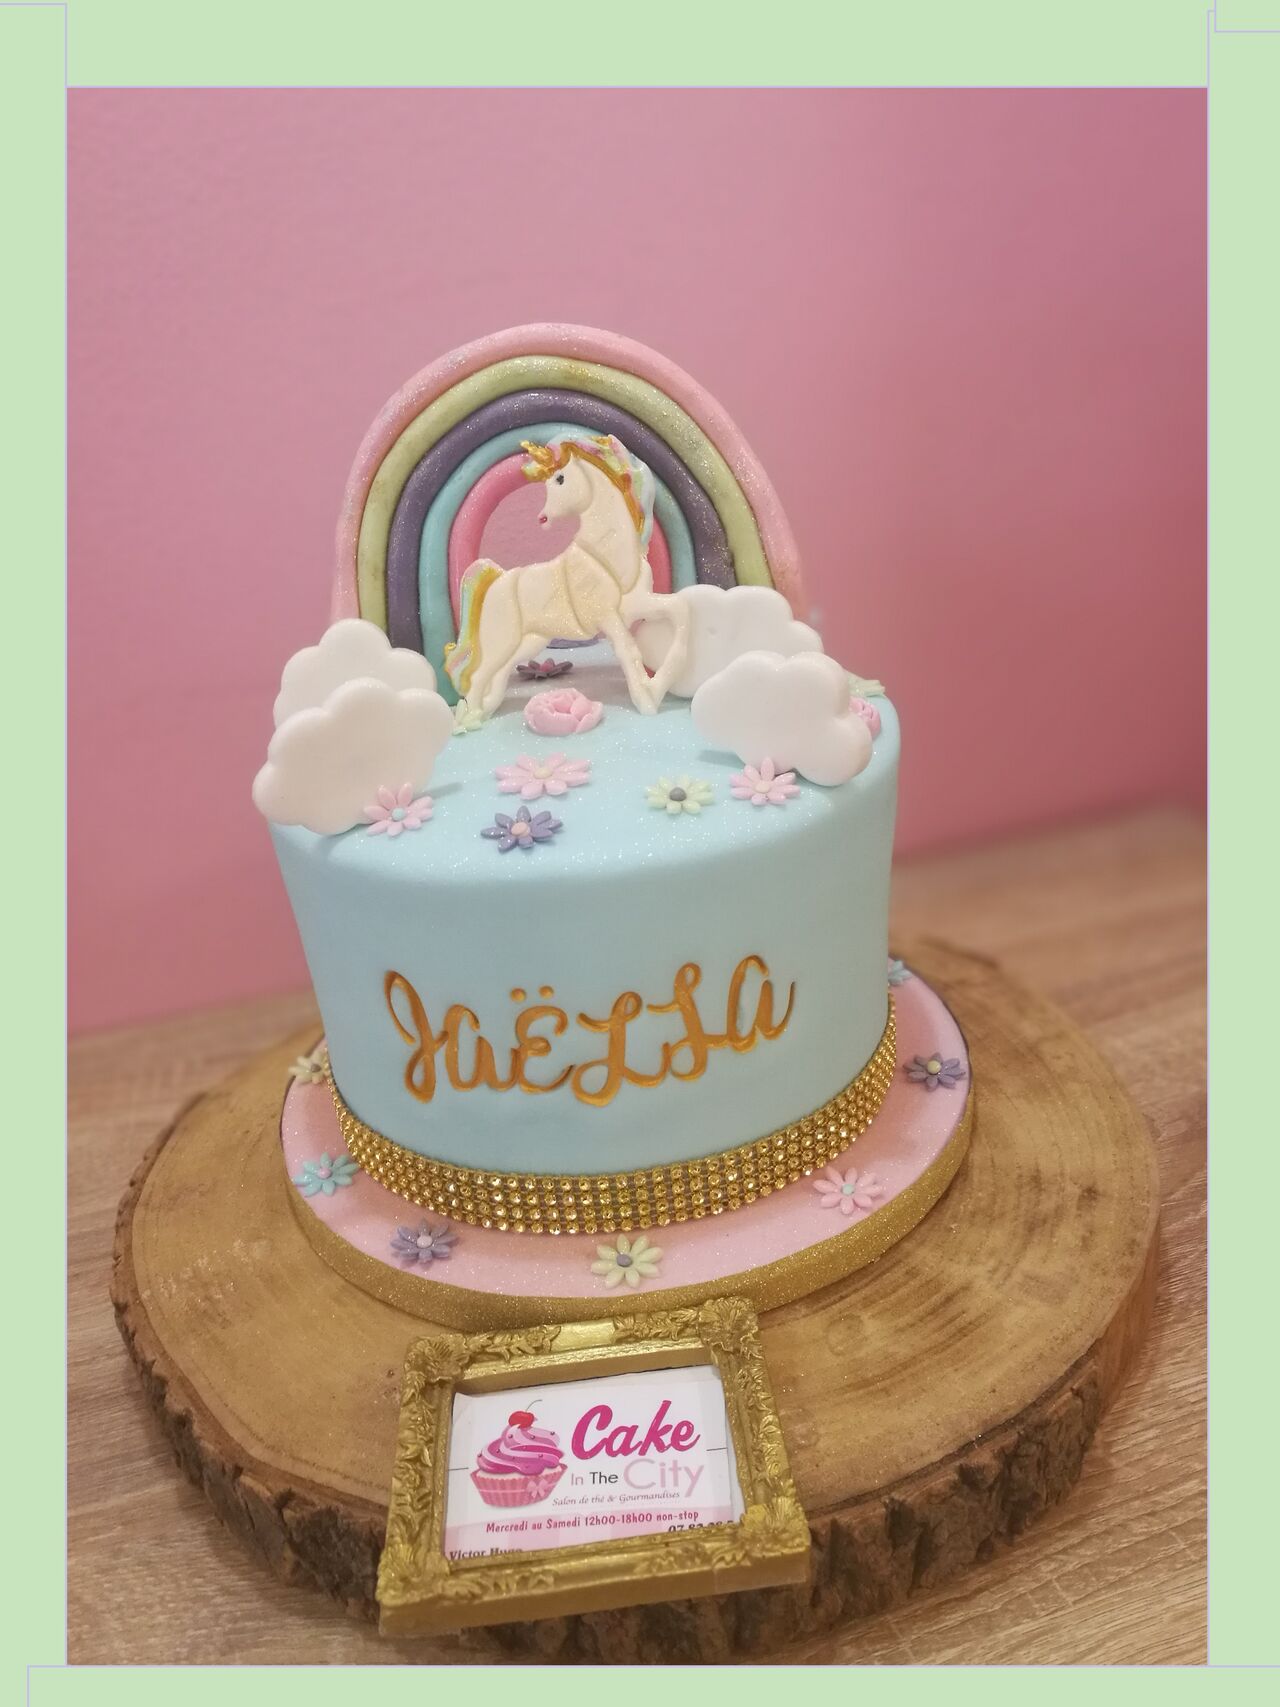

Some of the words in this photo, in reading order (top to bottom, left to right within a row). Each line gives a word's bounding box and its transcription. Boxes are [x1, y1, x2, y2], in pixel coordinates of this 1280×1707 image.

[571, 1400, 701, 1460] Cake
[571, 1472, 584, 1486] In
[590, 1471, 619, 1485] The
[623, 1457, 704, 1498] City
[552, 1497, 577, 1506] Salon
[579, 1495, 589, 1504] de
[607, 1495, 616, 1503] &
[619, 1490, 681, 1504] Gourmandises
[486, 1520, 528, 1533] Mercredi
[532, 1522, 542, 1530] au
[546, 1517, 581, 1529] Samedi
[585, 1512, 653, 1526] 12h00-18h00
[656, 1510, 699, 1521] non-stop
